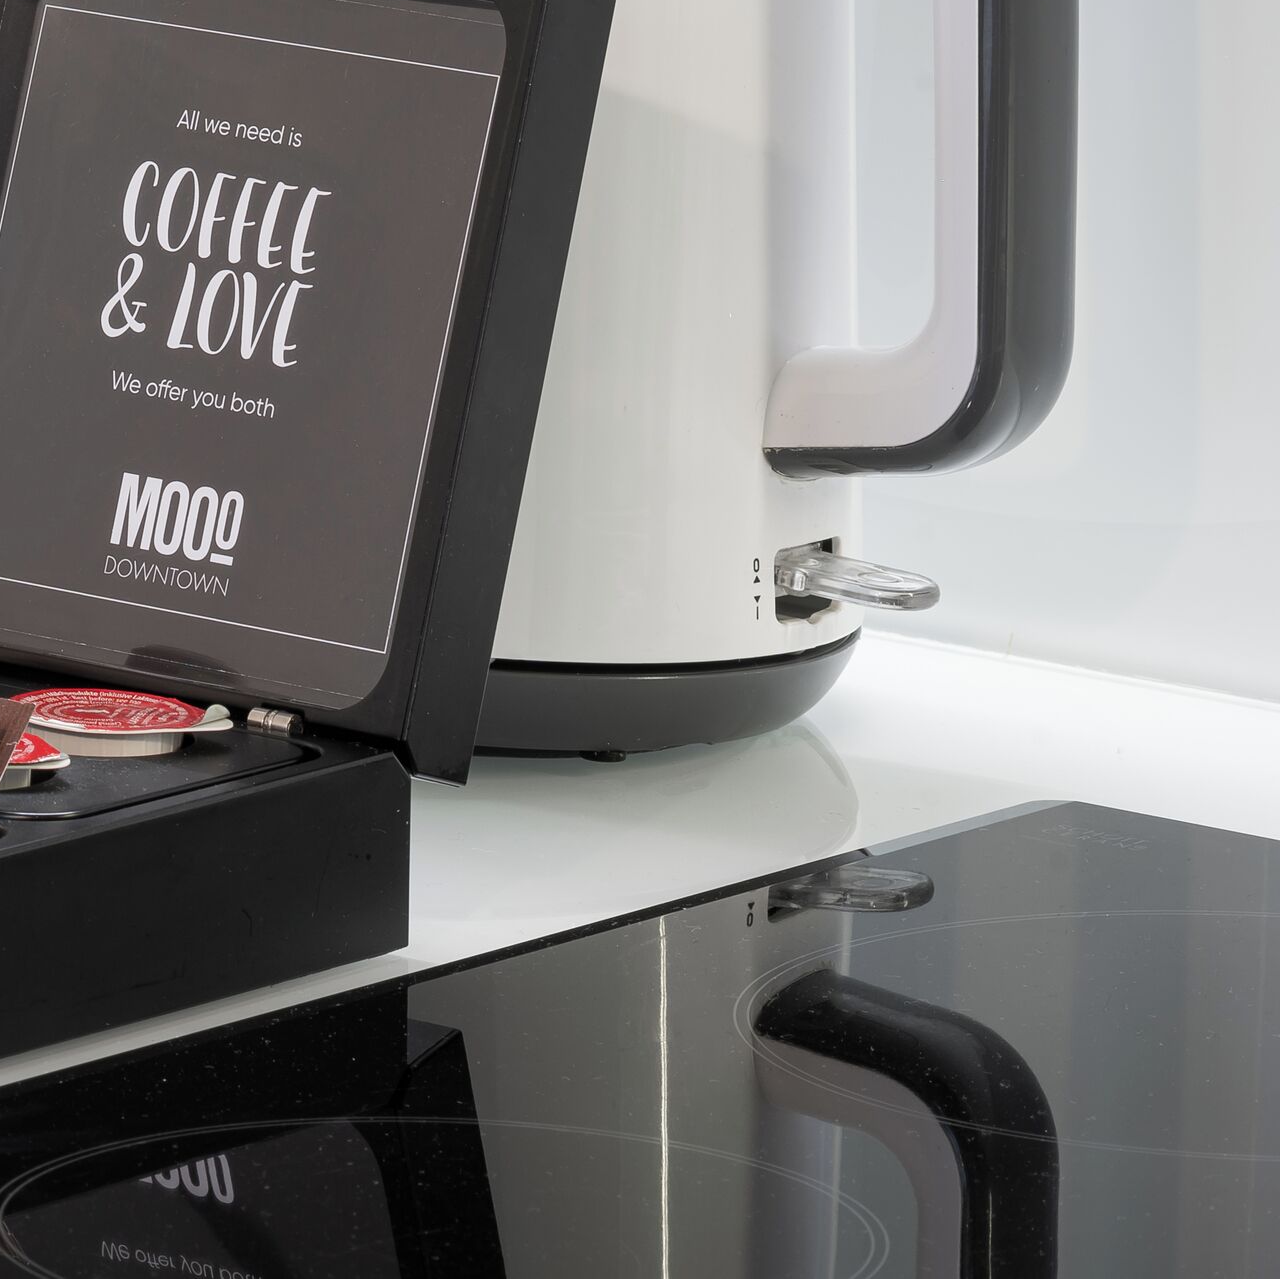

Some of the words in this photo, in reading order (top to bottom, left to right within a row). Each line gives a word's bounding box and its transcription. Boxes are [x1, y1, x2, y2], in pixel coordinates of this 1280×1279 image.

[176, 109, 201, 131] All
[205, 117, 231, 136] we
[235, 124, 286, 145] need
[287, 130, 303, 148] is
[122, 160, 332, 275] COFFEE
[100, 252, 148, 338] &
[166, 262, 314, 368] LOVE
[112, 370, 142, 394] We
[145, 378, 189, 402] offer
[190, 389, 226, 410] you
[230, 391, 275, 419] both
[103, 555, 230, 597] DOWNTOWN
